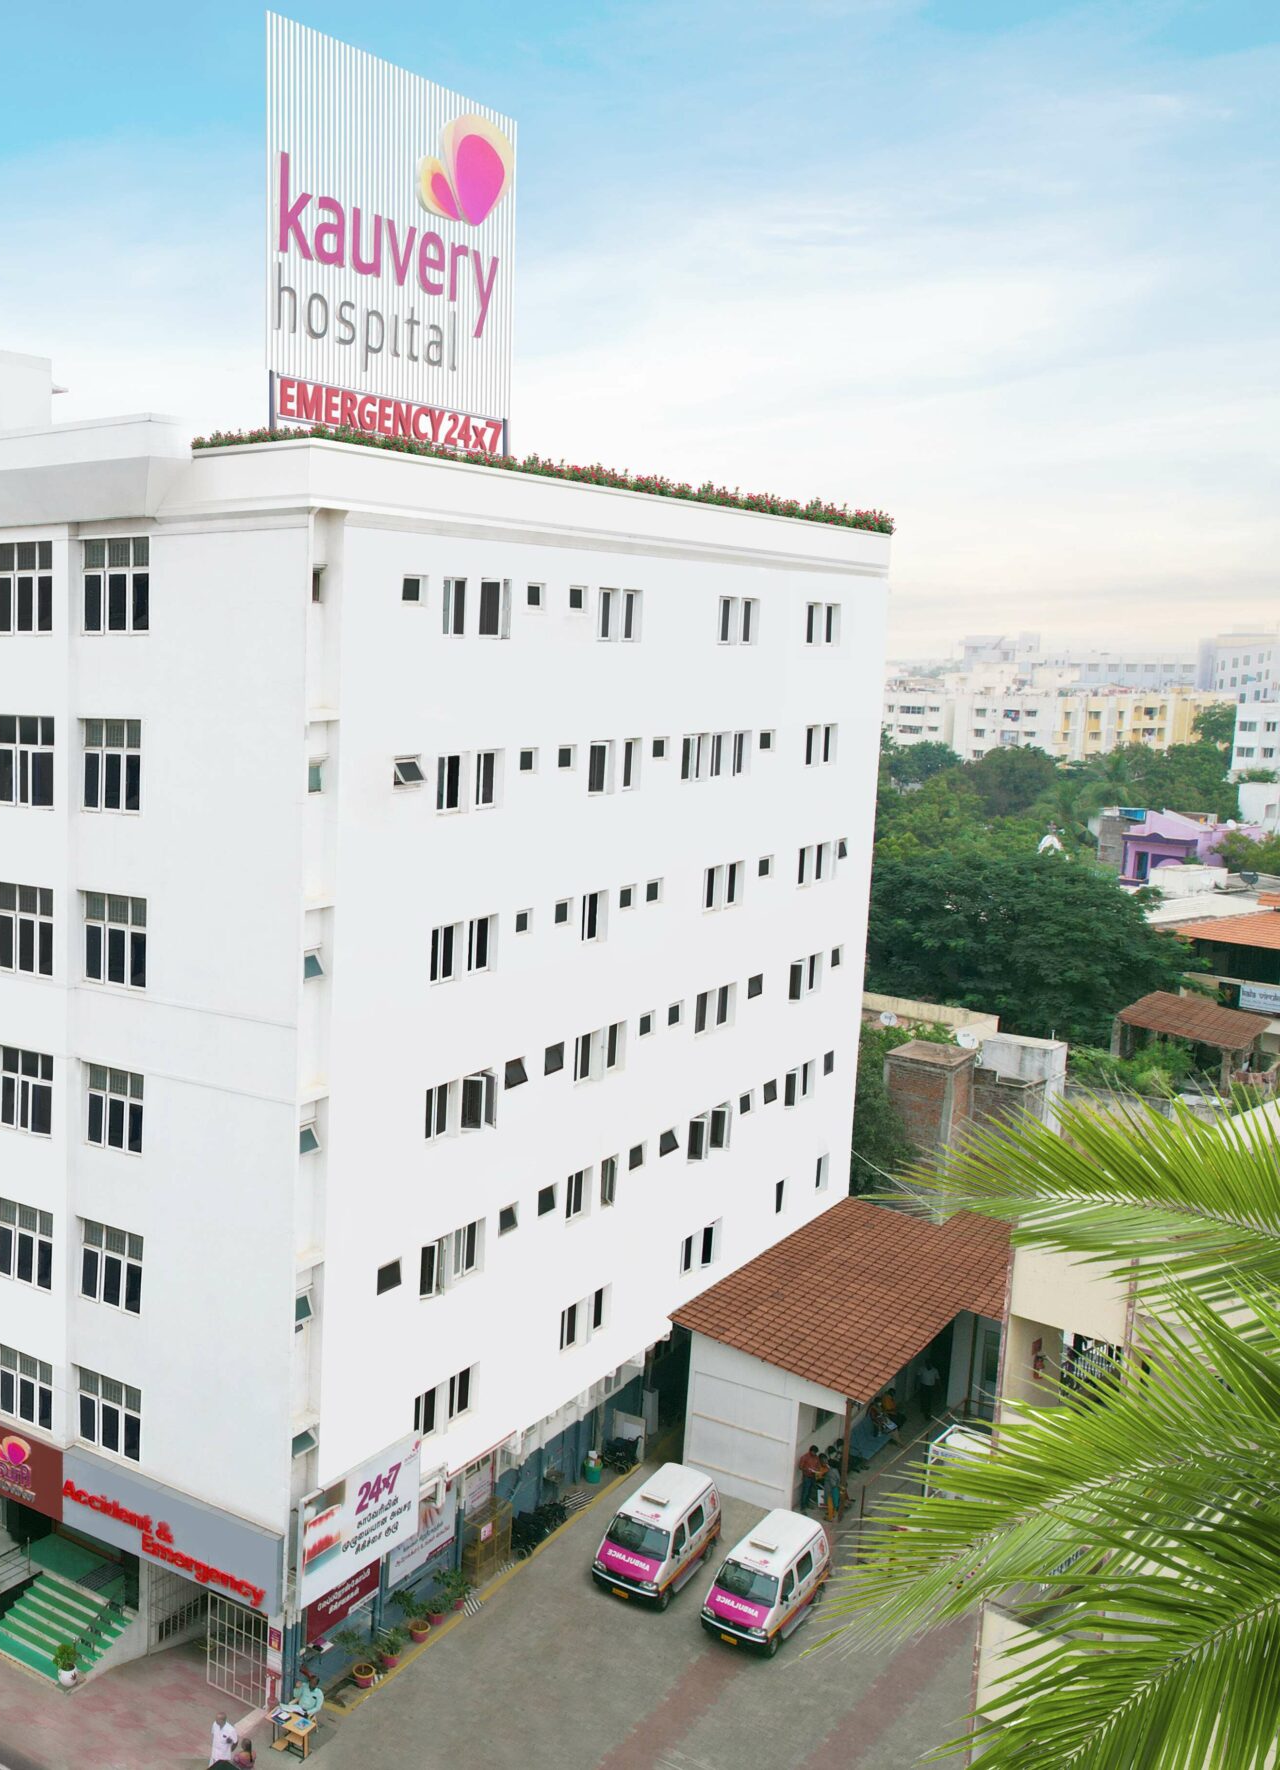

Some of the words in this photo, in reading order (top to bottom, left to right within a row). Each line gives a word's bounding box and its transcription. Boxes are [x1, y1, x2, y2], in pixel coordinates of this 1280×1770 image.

[274, 151, 499, 338] kauvery
[274, 261, 457, 372] hospital
[280, 378, 444, 443] EMERGENCY
[445, 413, 503, 453] 24x7
[63, 1478, 153, 1534] Accident
[156, 1520, 174, 1544] &
[355, 1461, 402, 1516] 24x7
[141, 1532, 266, 1608] Emergency
